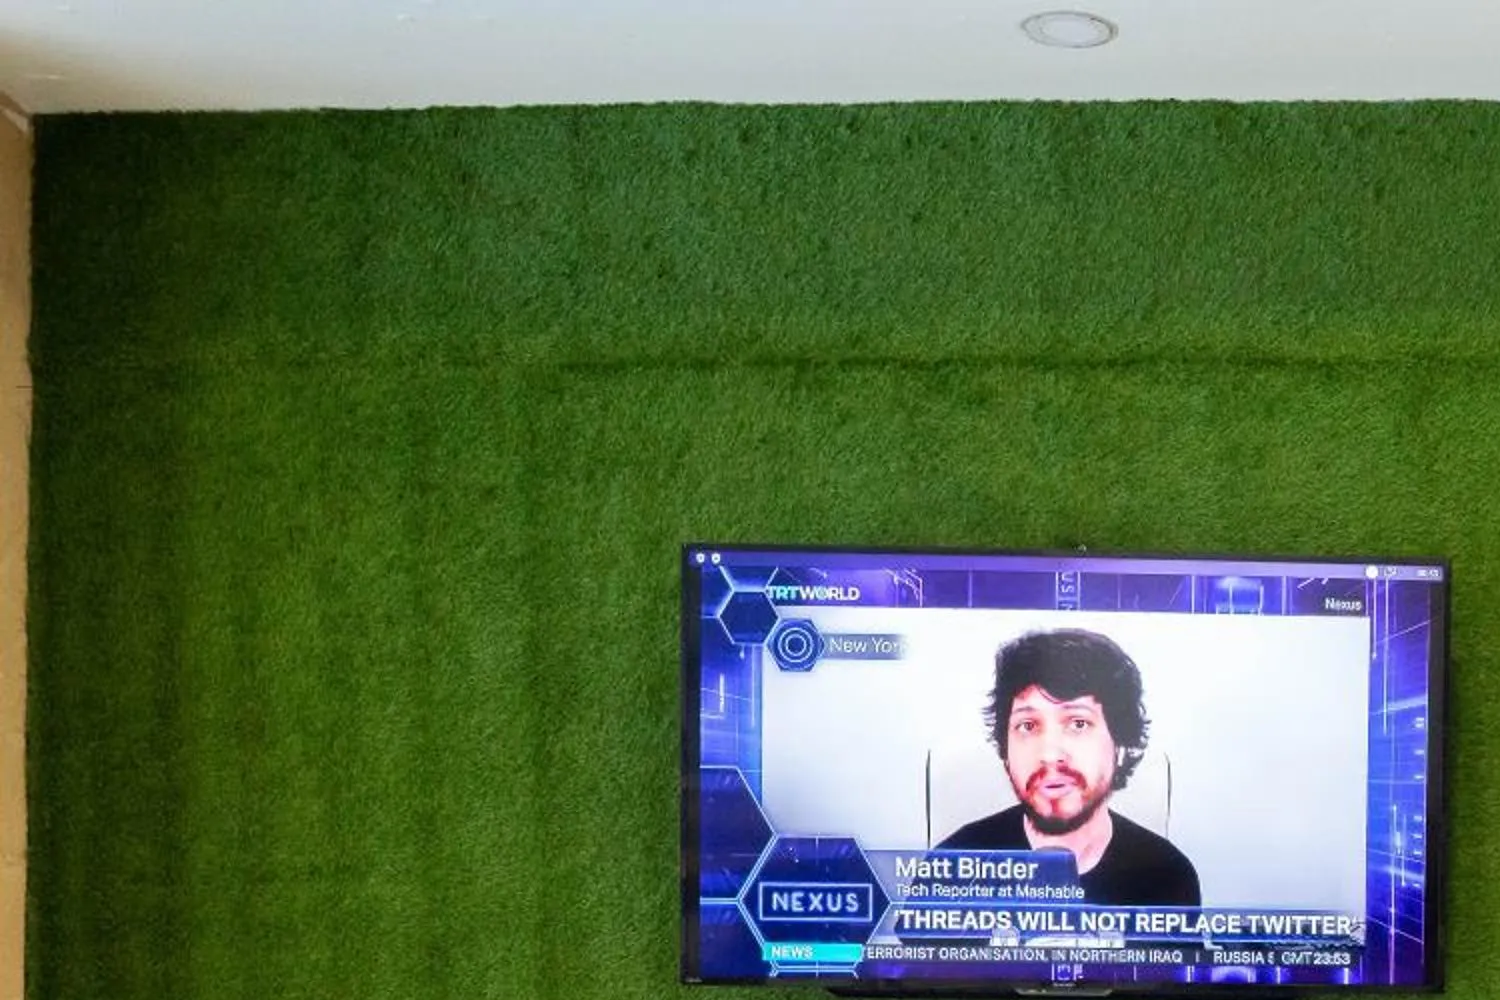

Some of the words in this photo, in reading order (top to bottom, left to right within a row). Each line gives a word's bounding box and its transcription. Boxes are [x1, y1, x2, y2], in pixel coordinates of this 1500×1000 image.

[1325, 597, 1362, 611] Nexus
[830, 636, 868, 654] New
[895, 857, 952, 878] Matt
[957, 857, 1039, 879] Binder
[896, 883, 929, 898] Tech
[932, 883, 995, 901] Reporter
[997, 886, 1013, 898] at
[1016, 884, 1086, 900] Mashable
[771, 891, 860, 912] NEXUS
[1017, 911, 1075, 931] WILL
[1081, 913, 1130, 932] NOT
[1135, 914, 1241, 933] REPLACE
[771, 945, 814, 959] NEWS
[867, 947, 935, 960] ERRORIST
[1051, 949, 1067, 962] IN
[1069, 949, 1146, 963] NORTHERN
[1149, 949, 1184, 963] IRAQ
[1213, 950, 1264, 964] RUSSIA
[1281, 951, 1313, 965] GMT
